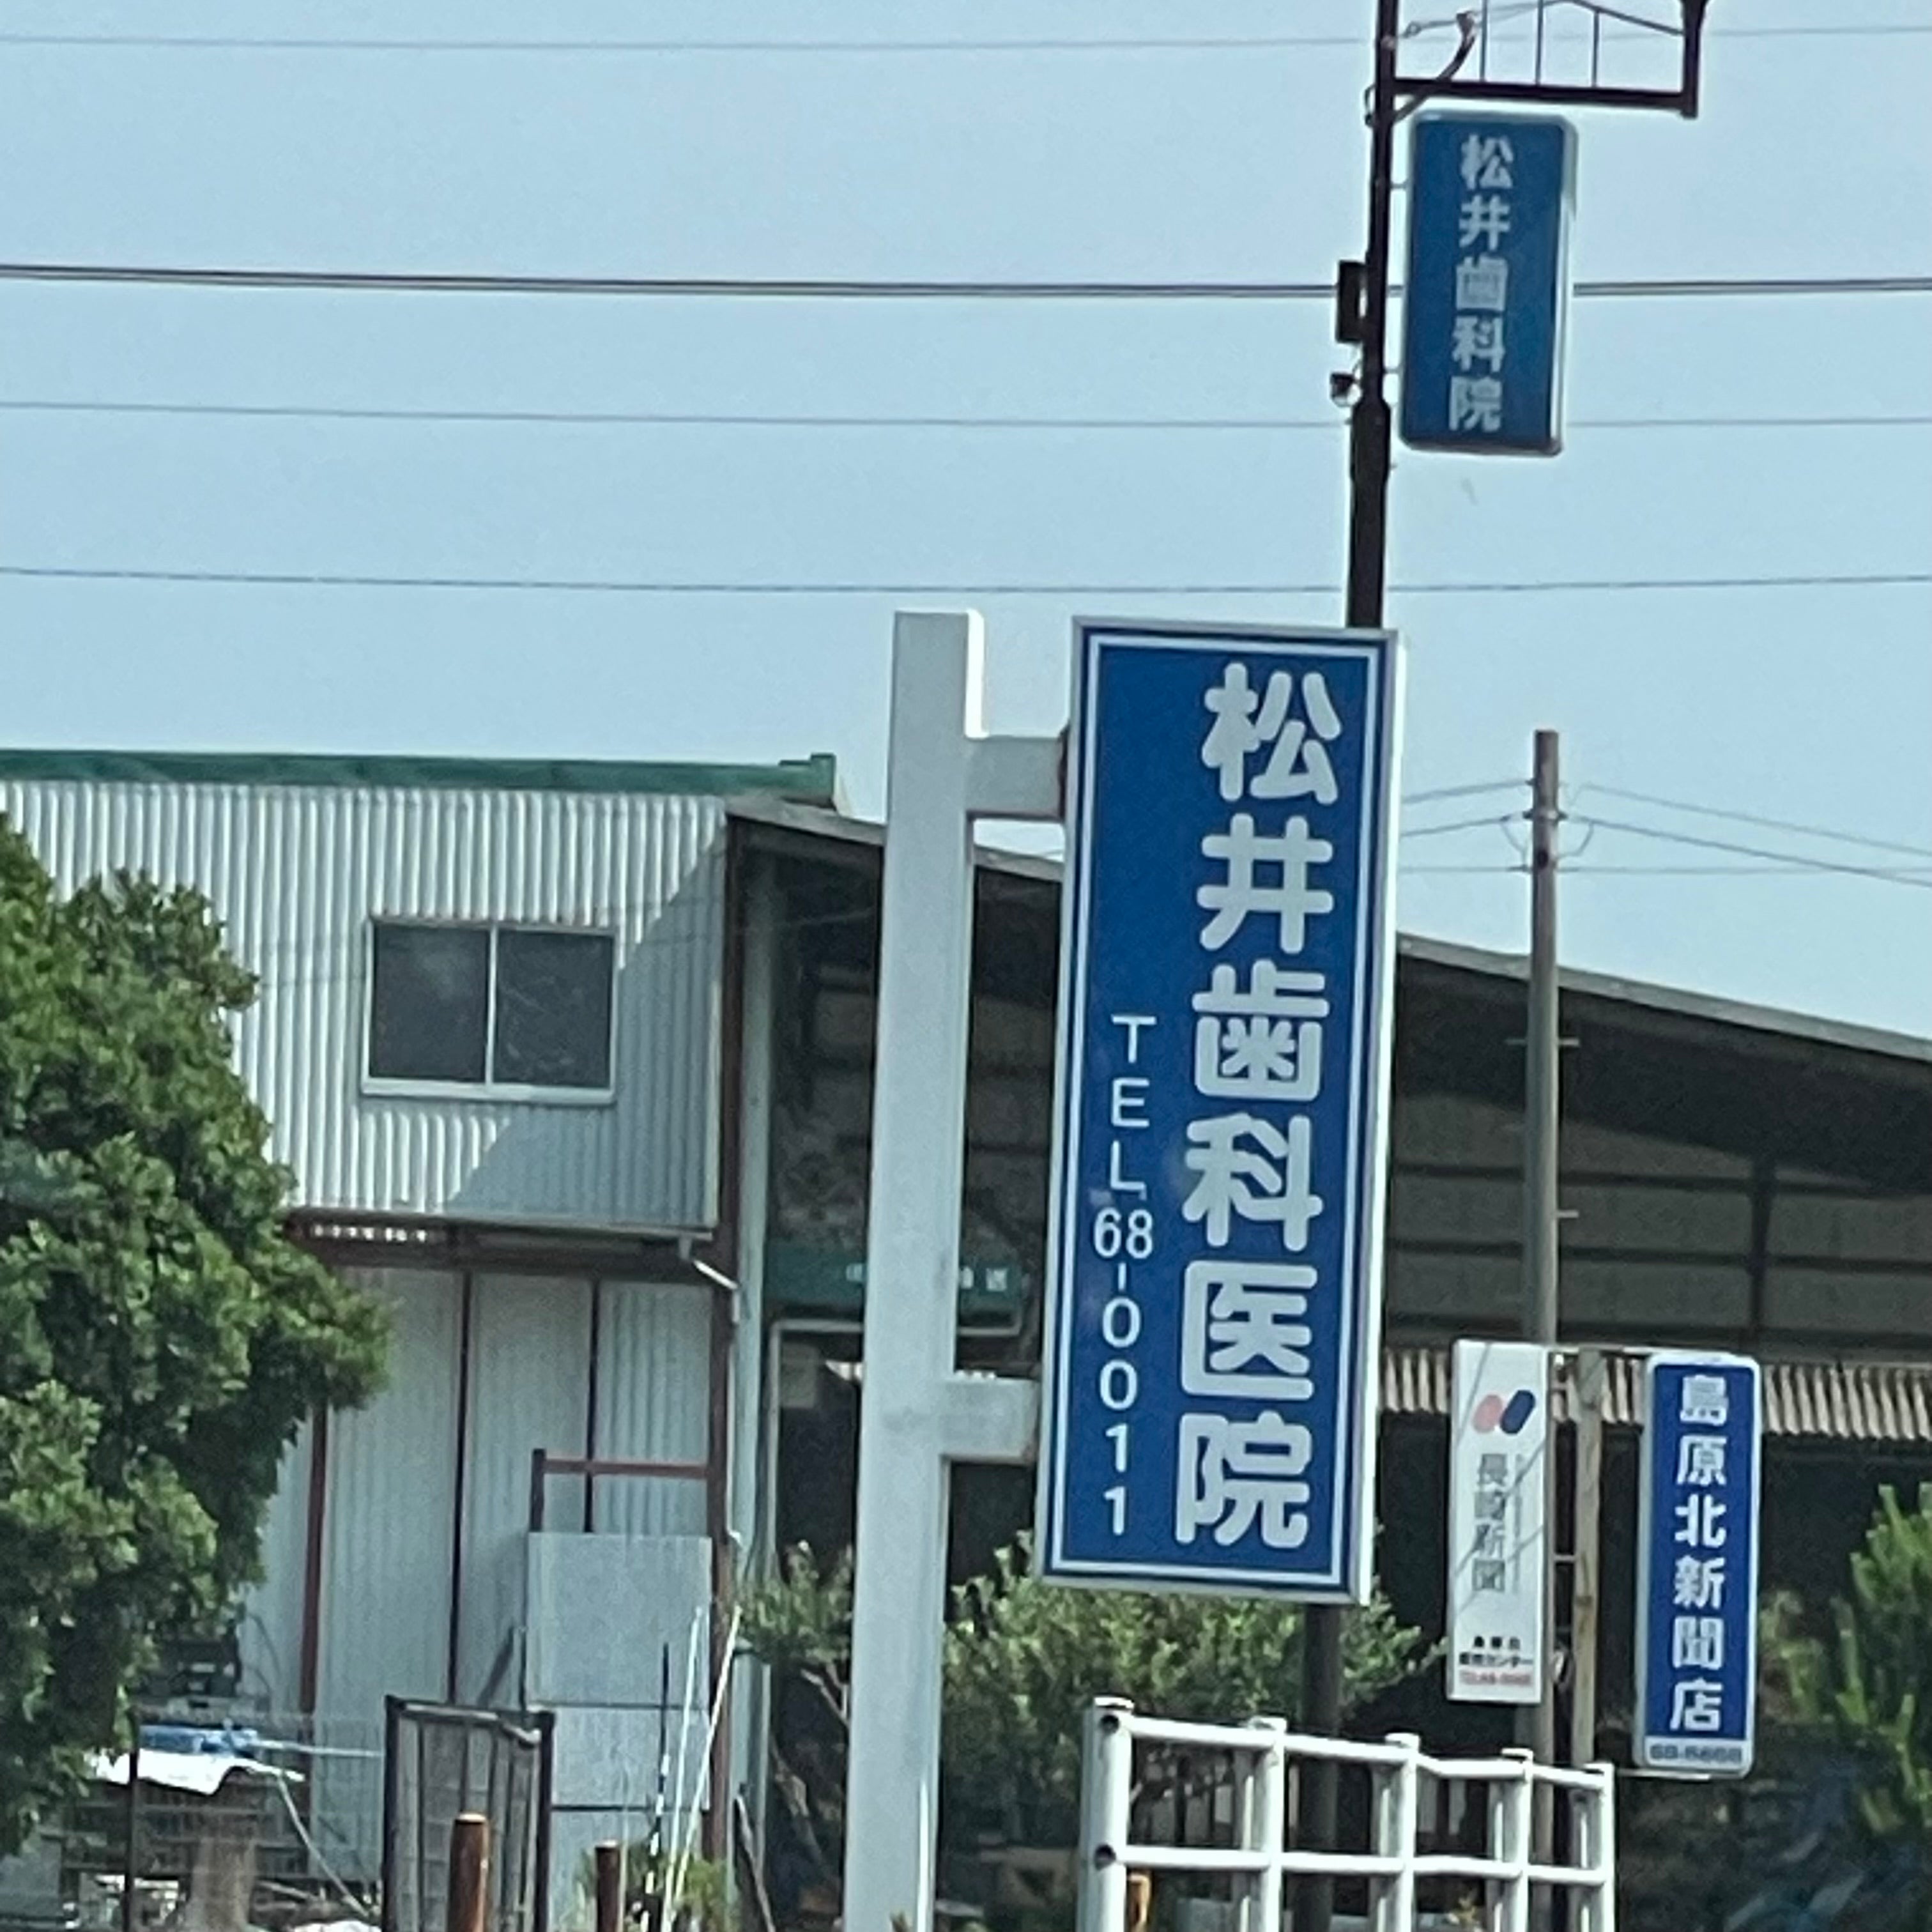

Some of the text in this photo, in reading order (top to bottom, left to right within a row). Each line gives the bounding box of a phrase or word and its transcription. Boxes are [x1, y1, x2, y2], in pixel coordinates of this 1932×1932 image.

[1448, 133, 1514, 433] 松井歯科院
[1175, 661, 1342, 1549] 松井歯科医院
[1669, 1374, 1729, 1733] 島原北新聞店
